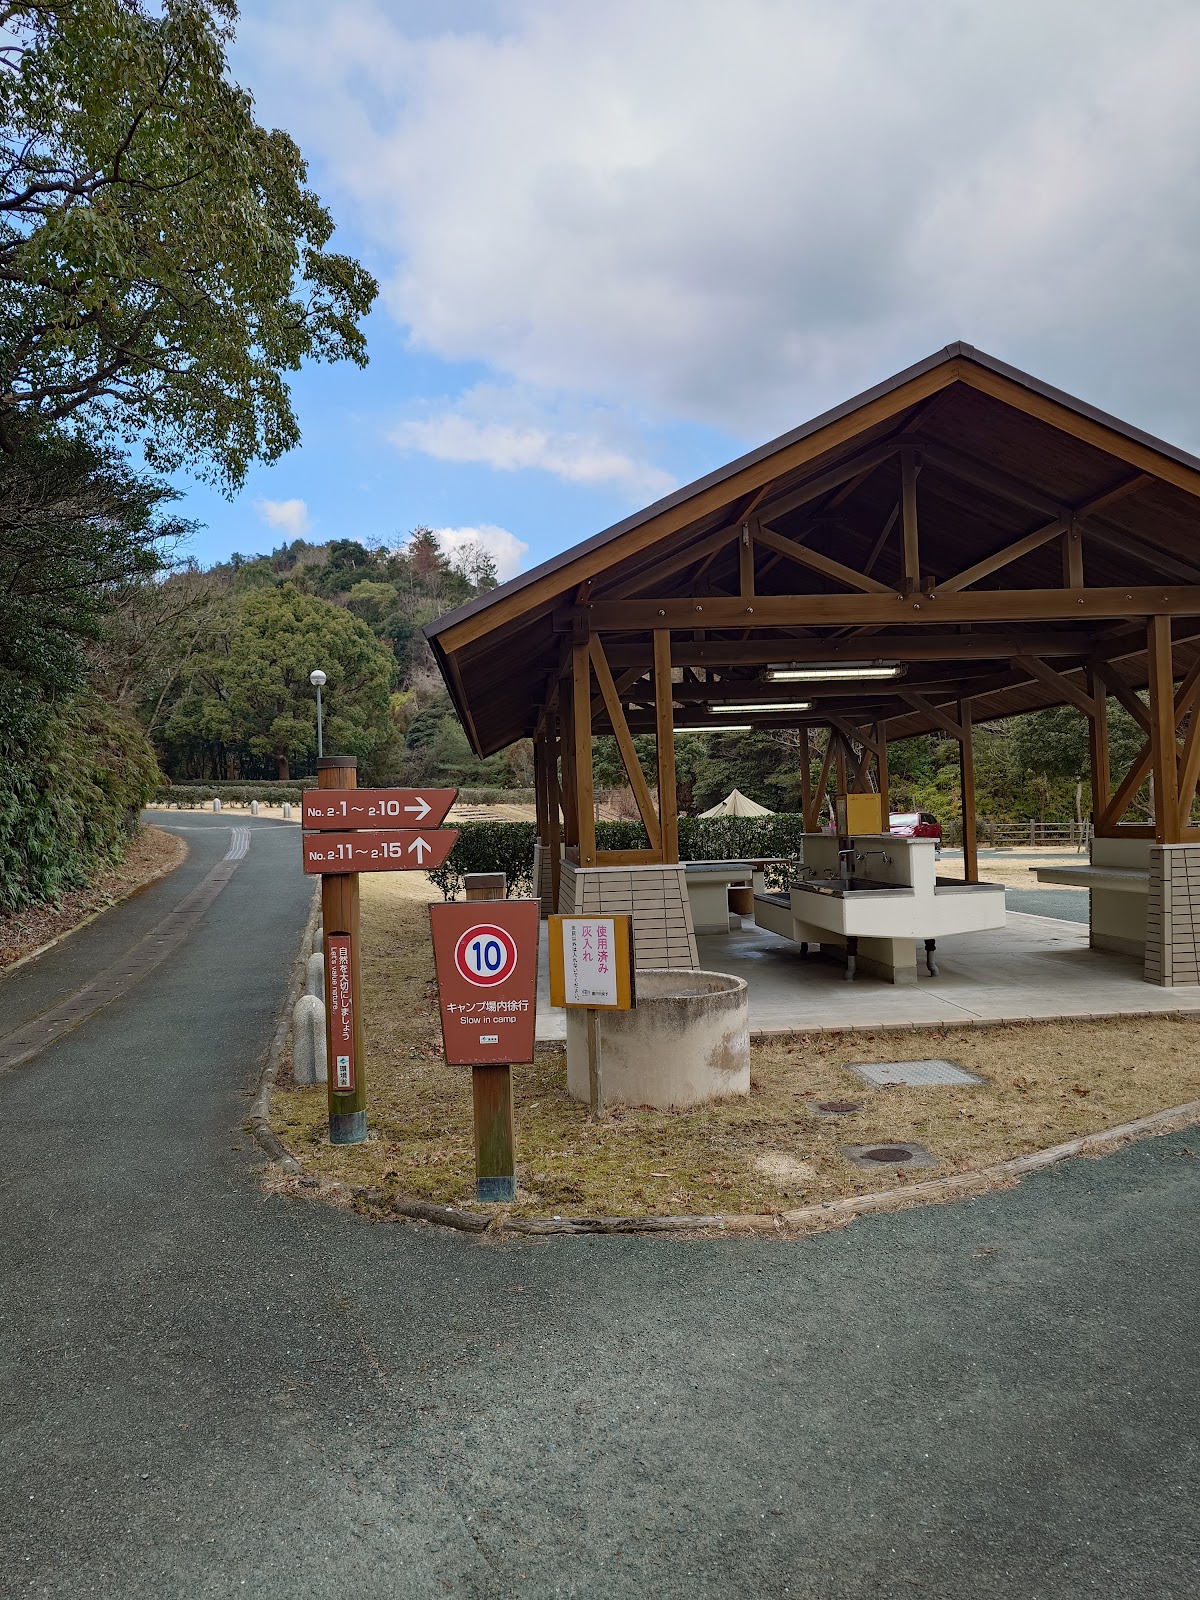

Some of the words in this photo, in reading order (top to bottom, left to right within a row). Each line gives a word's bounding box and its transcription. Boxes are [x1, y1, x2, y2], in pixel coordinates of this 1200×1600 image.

[472, 940, 502, 971] 10
[581, 925, 594, 963] 灰入れ
[596, 925, 609, 974] 使用済み
[331, 965, 339, 985] value
[339, 946, 350, 1041] 自然を大切にしましょう
[446, 1000, 529, 1014] キャンプ場内徐行
[460, 1016, 481, 1025] Slow
[483, 1015, 491, 1024] in
[492, 1015, 517, 1024] camp
